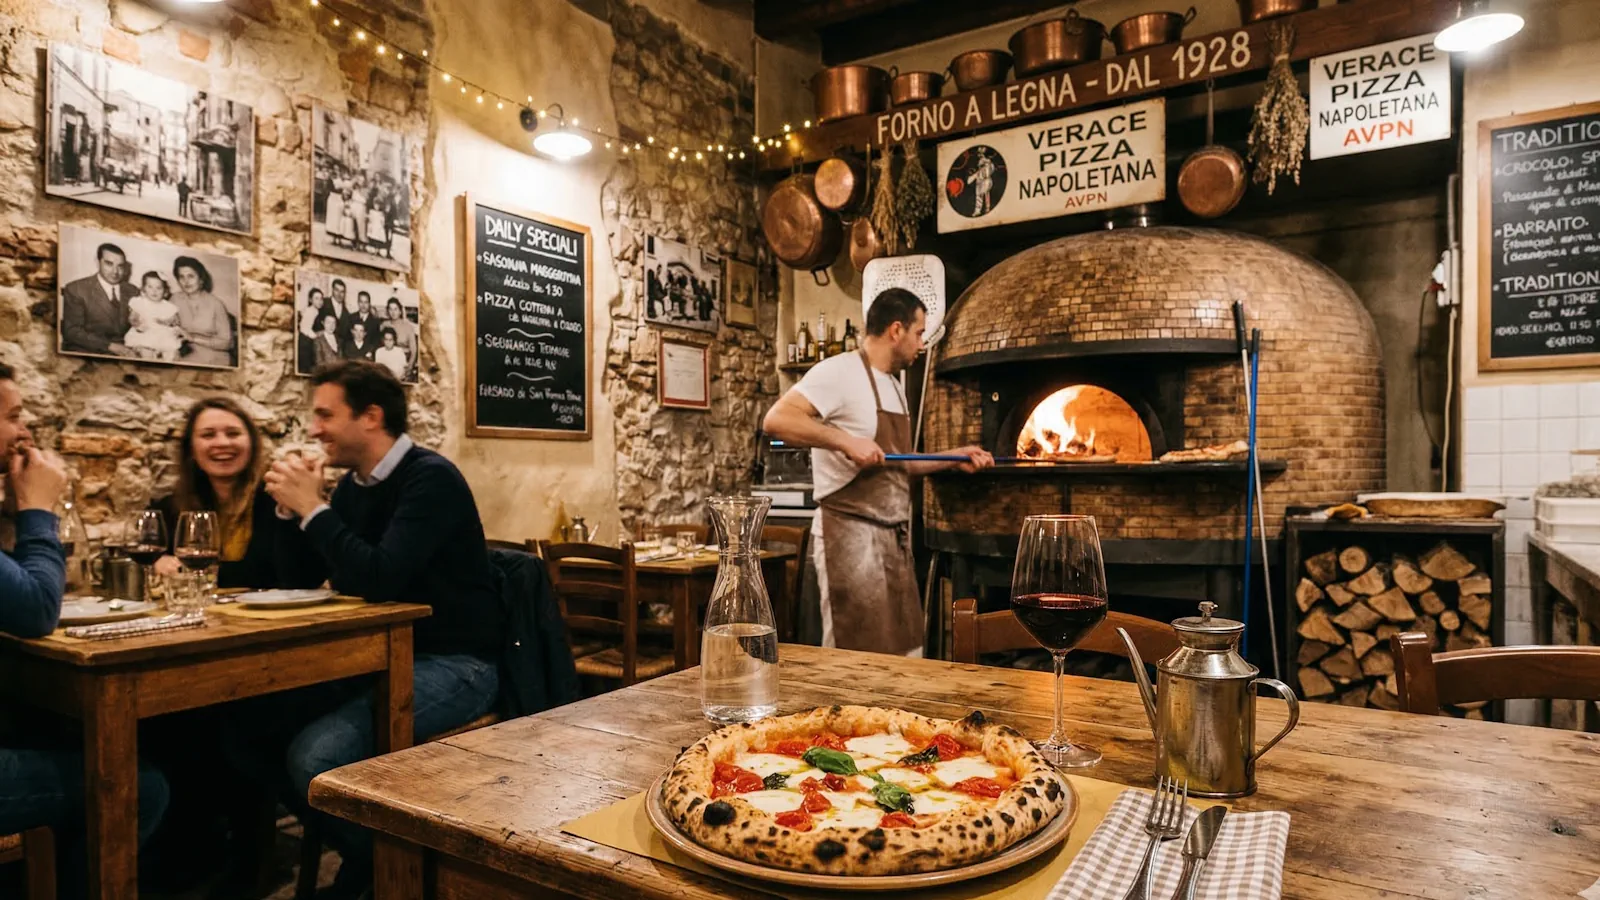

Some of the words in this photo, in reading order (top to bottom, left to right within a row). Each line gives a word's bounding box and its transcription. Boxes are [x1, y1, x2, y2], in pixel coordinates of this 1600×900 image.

[1323, 42, 1436, 81] VERACE
[877, 100, 955, 144] FORNO
[964, 95, 982, 127] A
[991, 72, 1077, 121] LEGNA
[1106, 55, 1160, 96] DAL
[1171, 30, 1251, 80] 1928
[1331, 70, 1425, 103] PIZZA
[1319, 92, 1440, 128] NAPOLETANA
[1027, 110, 1147, 150] VERACE
[1343, 119, 1413, 147] AVPN
[1039, 139, 1135, 172] PIZZA
[1019, 158, 1157, 200] NAPOLETANA
[1065, 191, 1108, 209] AVPN
[485, 214, 524, 242] DAILY
[526, 226, 578, 257] SPECIALI
[484, 291, 516, 310] PIZZA
